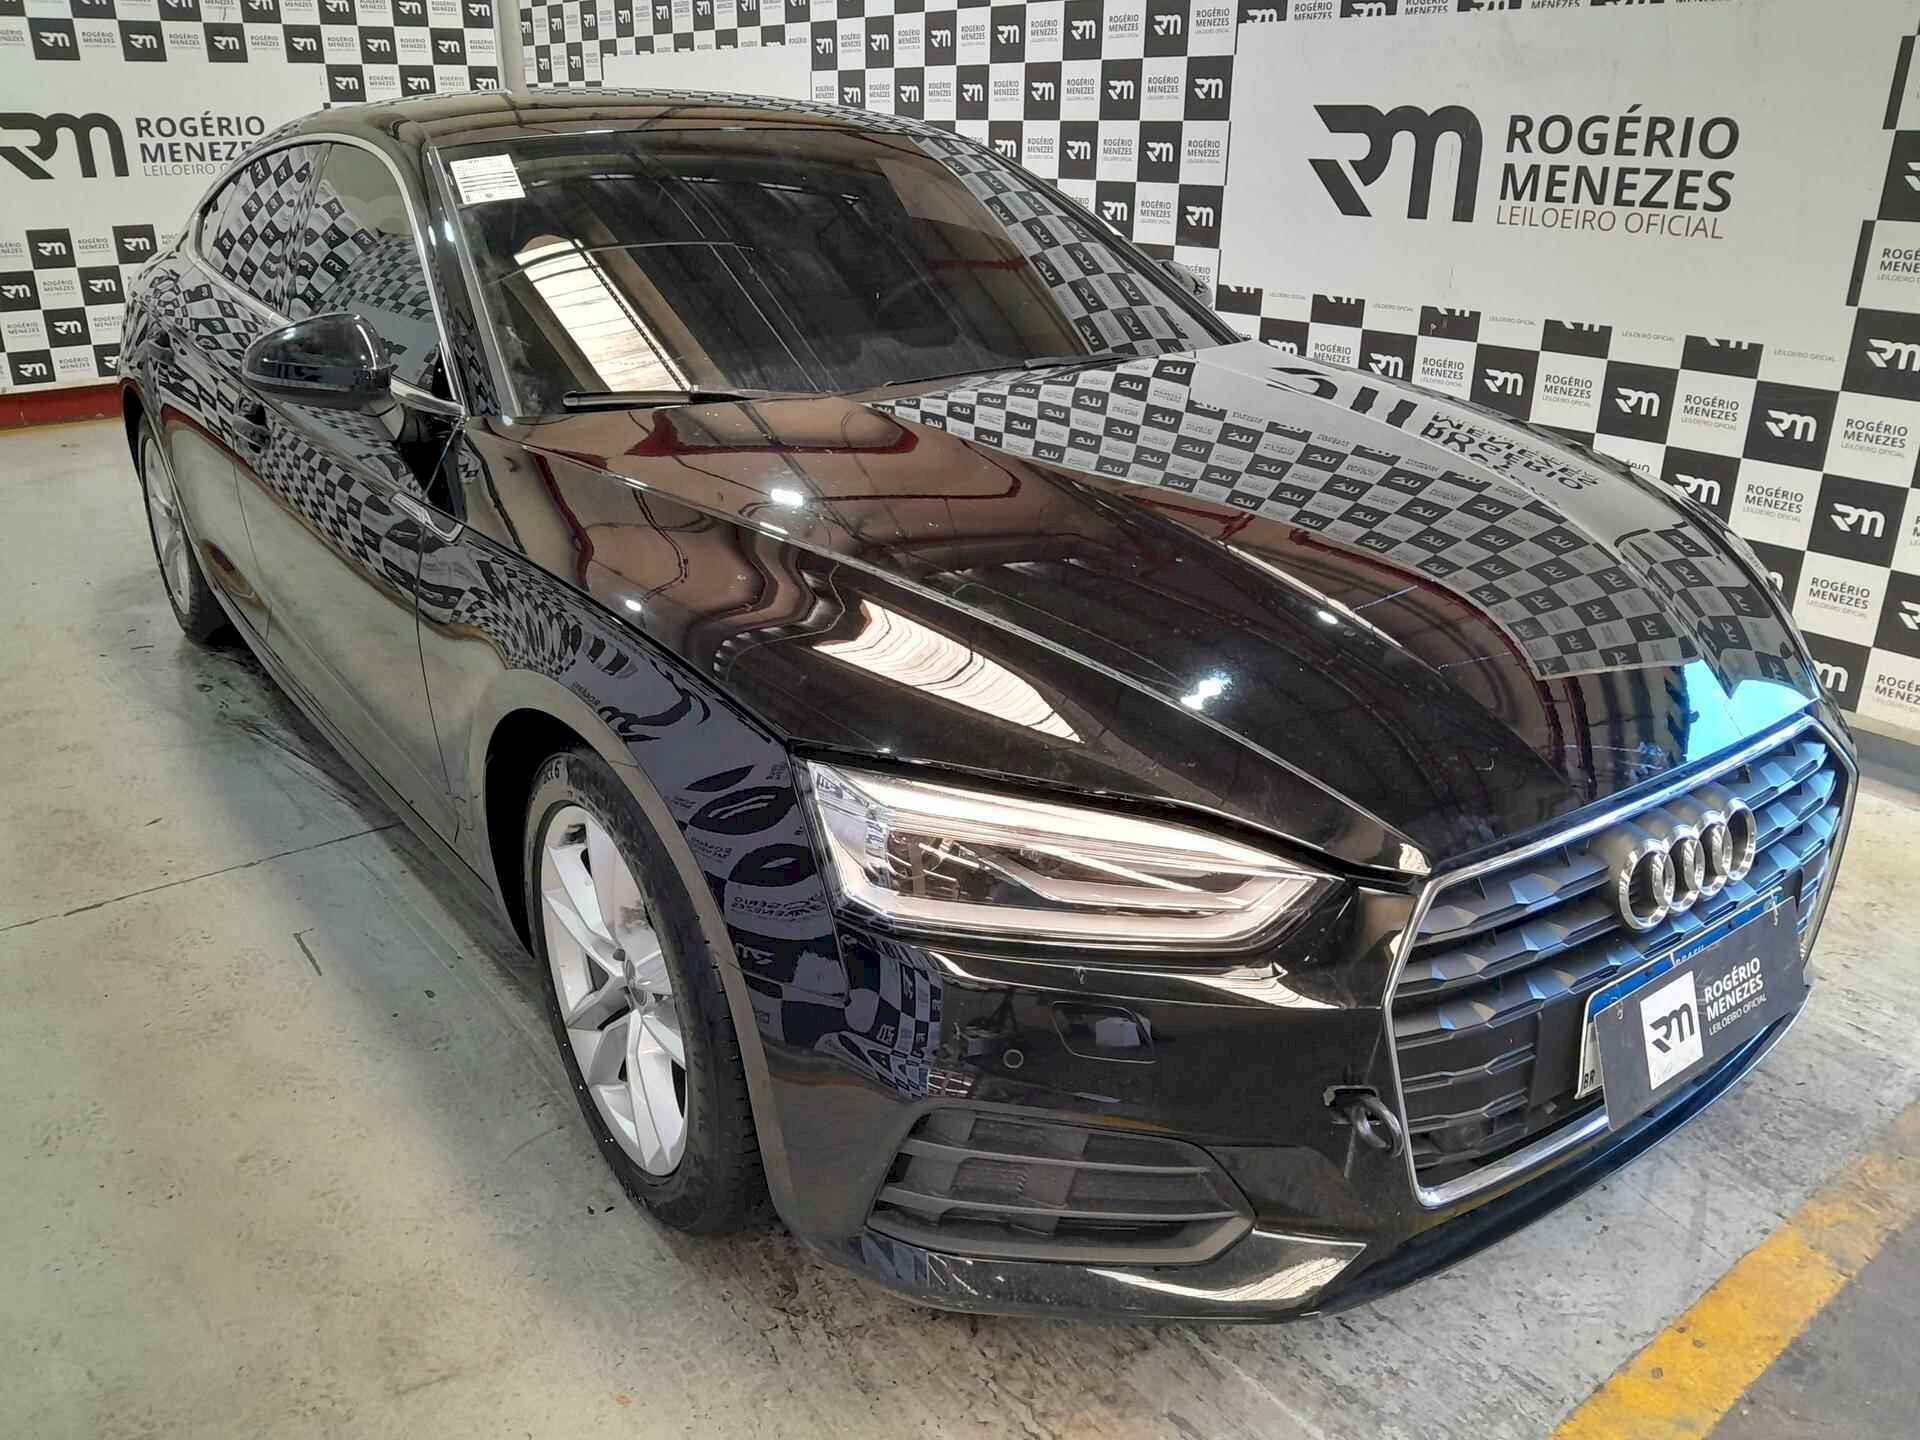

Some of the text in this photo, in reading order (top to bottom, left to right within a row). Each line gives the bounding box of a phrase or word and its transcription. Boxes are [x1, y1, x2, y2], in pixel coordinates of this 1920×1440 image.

[1196, 7, 1230, 18] ROGÉRIO
[1294, 1, 1334, 12] ROGÉRIO
[1031, 18, 1058, 28] ROGÉRIO
[1109, 12, 1139, 24] ROGÉRIO
[1196, 18, 1230, 27] MENEZES
[1031, 28, 1058, 36] MENEZES
[1109, 23, 1139, 32] MENEZES
[962, 32, 986, 40] MENEZES
[1066, 76, 1095, 86] ROGÉRIO
[1148, 74, 1179, 85] ROGÉRIO
[994, 88, 1020, 96] MENEZES
[1066, 86, 1095, 95] MENEZES
[1148, 85, 1179, 94] MENEZES
[135, 110, 265, 137] ROGÉRIO
[1505, 103, 1740, 160] ROGÉRIO
[1027, 134, 1054, 145] ROGÉRIO
[1103, 135, 1133, 146] ROGÉRIO
[1187, 137, 1220, 148] ROGÉRIO
[140, 141, 251, 164] MENEZ
[1027, 145, 1054, 154] MENEZES
[1103, 146, 1133, 156] MENEZES
[1187, 148, 1220, 158] MENEZES
[143, 163, 216, 176] LEILOEIRO
[1500, 163, 1736, 212] MENEZES
[1141, 198, 1172, 210] ROGÉRIO
[1141, 209, 1172, 220] MENEZES
[1496, 205, 1724, 240] LEILOEIRO OFICIAL
[1314, 340, 1352, 354] ROGÉRIO
[1313, 352, 1351, 364] MENEZES
[1422, 355, 1465, 371] ROGÉRIO
[1421, 367, 1464, 380] MENEZES
[1545, 372, 1593, 390] ROGÉRIO
[1543, 384, 1592, 400] MENEZES
[1684, 392, 1740, 412] ROGÉRIO
[1682, 405, 1738, 422] MENEZES
[1846, 416, 1908, 438] ROGÉRIO
[1843, 430, 1907, 450] MENEZES
[1746, 482, 1804, 502] ROGÉRIO
[1744, 494, 1802, 514] MENEZES
[1810, 576, 1870, 598] ROGÉRIO
[1808, 588, 1869, 610] MENEZES
[1704, 956, 1760, 1004] ROGÉRIO
[1706, 974, 1764, 1022] MENEZES
[1709, 993, 1767, 1036] LEILOEIRO OFICIAL
[1584, 1069, 1596, 1090] BR
